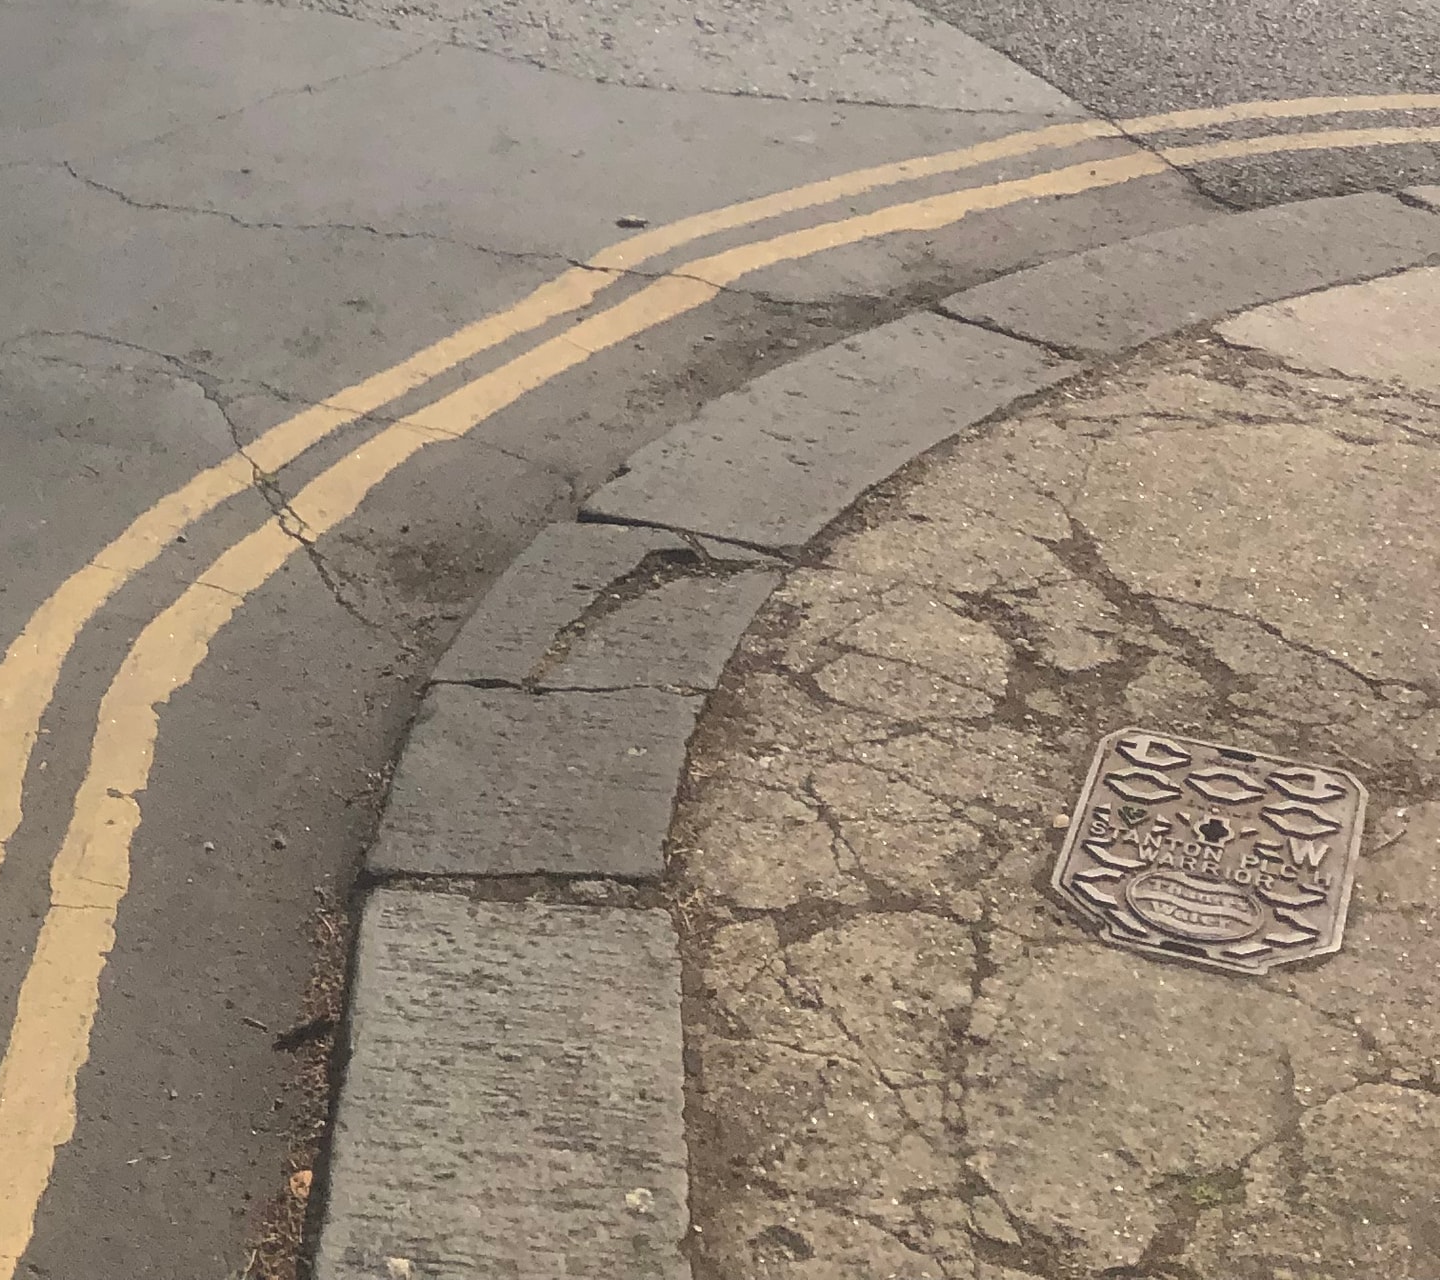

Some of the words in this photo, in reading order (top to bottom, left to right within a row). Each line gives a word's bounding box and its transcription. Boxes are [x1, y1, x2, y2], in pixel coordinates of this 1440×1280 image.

[1091, 820, 1224, 863] STANTON
[1241, 853, 1297, 880] PLC
[1138, 844, 1274, 890] WARRIOR
[1288, 837, 1330, 867] W
